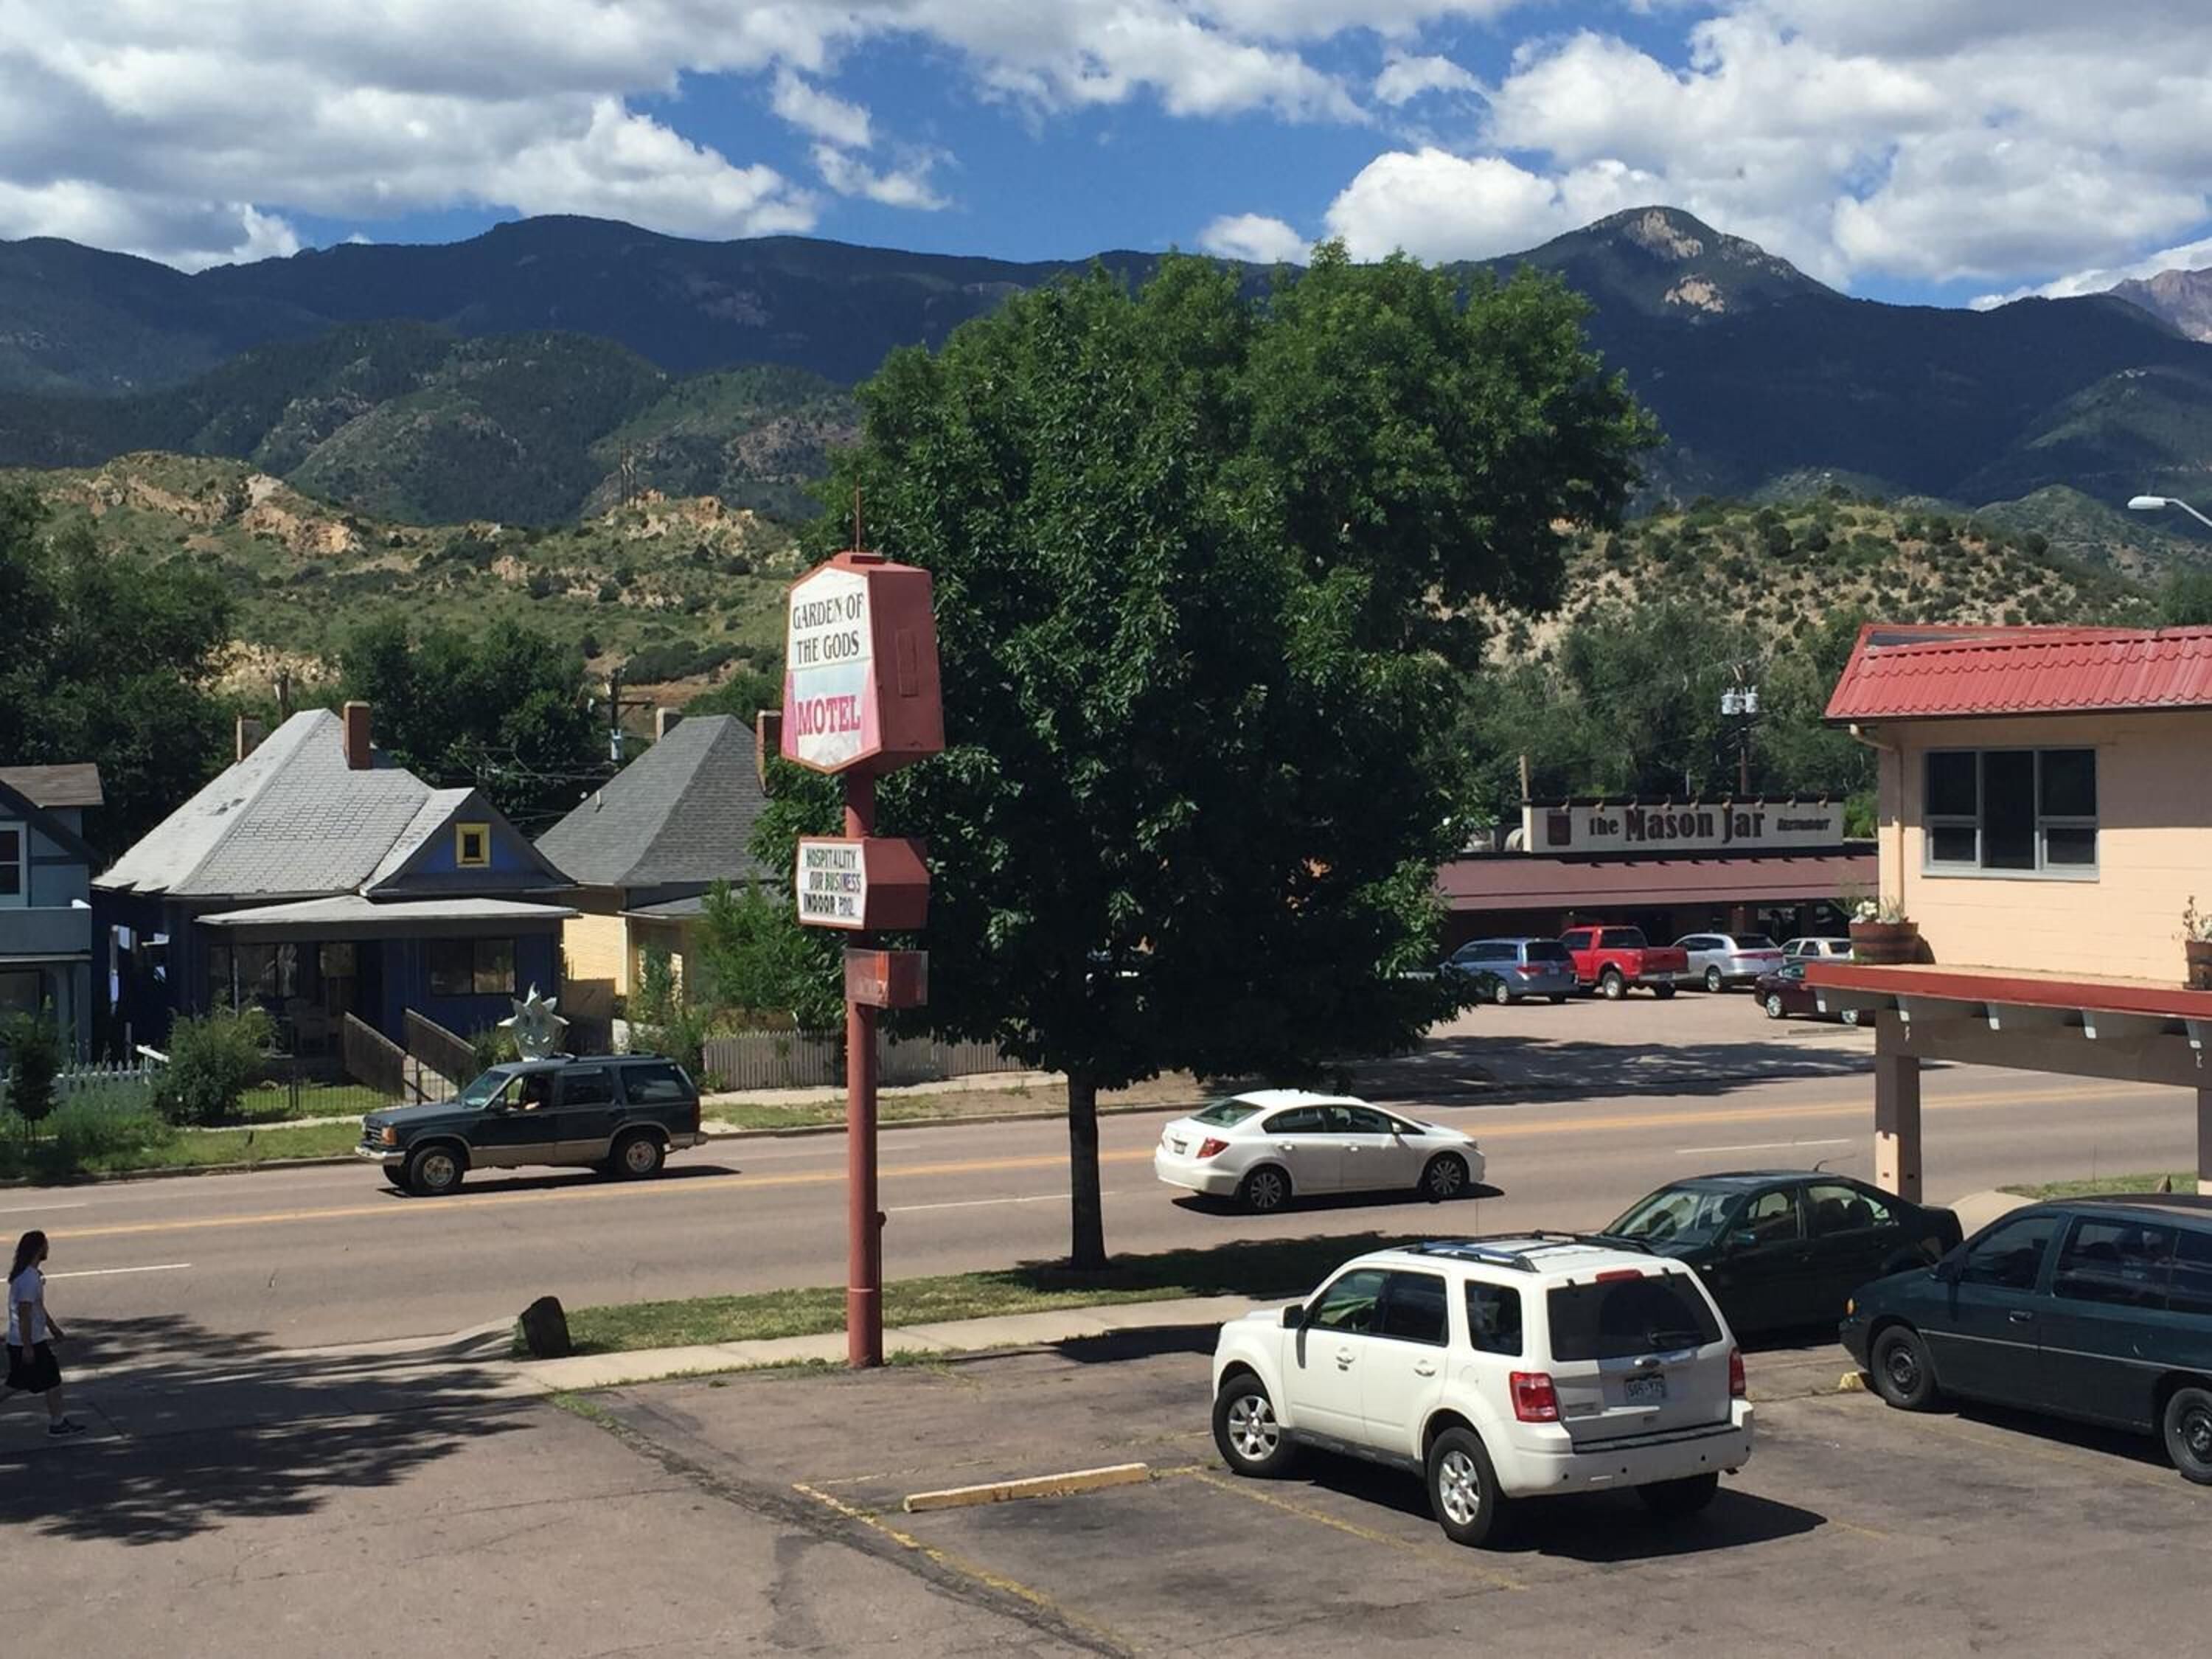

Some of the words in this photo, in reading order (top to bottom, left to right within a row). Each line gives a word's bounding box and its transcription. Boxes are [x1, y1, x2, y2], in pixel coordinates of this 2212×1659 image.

[793, 597, 843, 630] GARDEN
[846, 592, 864, 621] OF
[797, 635, 819, 664] THE
[824, 630, 859, 660] GODS
[798, 695, 860, 736] MOTEL
[1589, 816, 1619, 835] the
[1625, 810, 1714, 841] Mason
[806, 849, 857, 869] HOSPITALITY
[810, 872, 824, 891] OUR
[825, 872, 861, 893] BUSINESS
[803, 893, 835, 914] INDOOR
